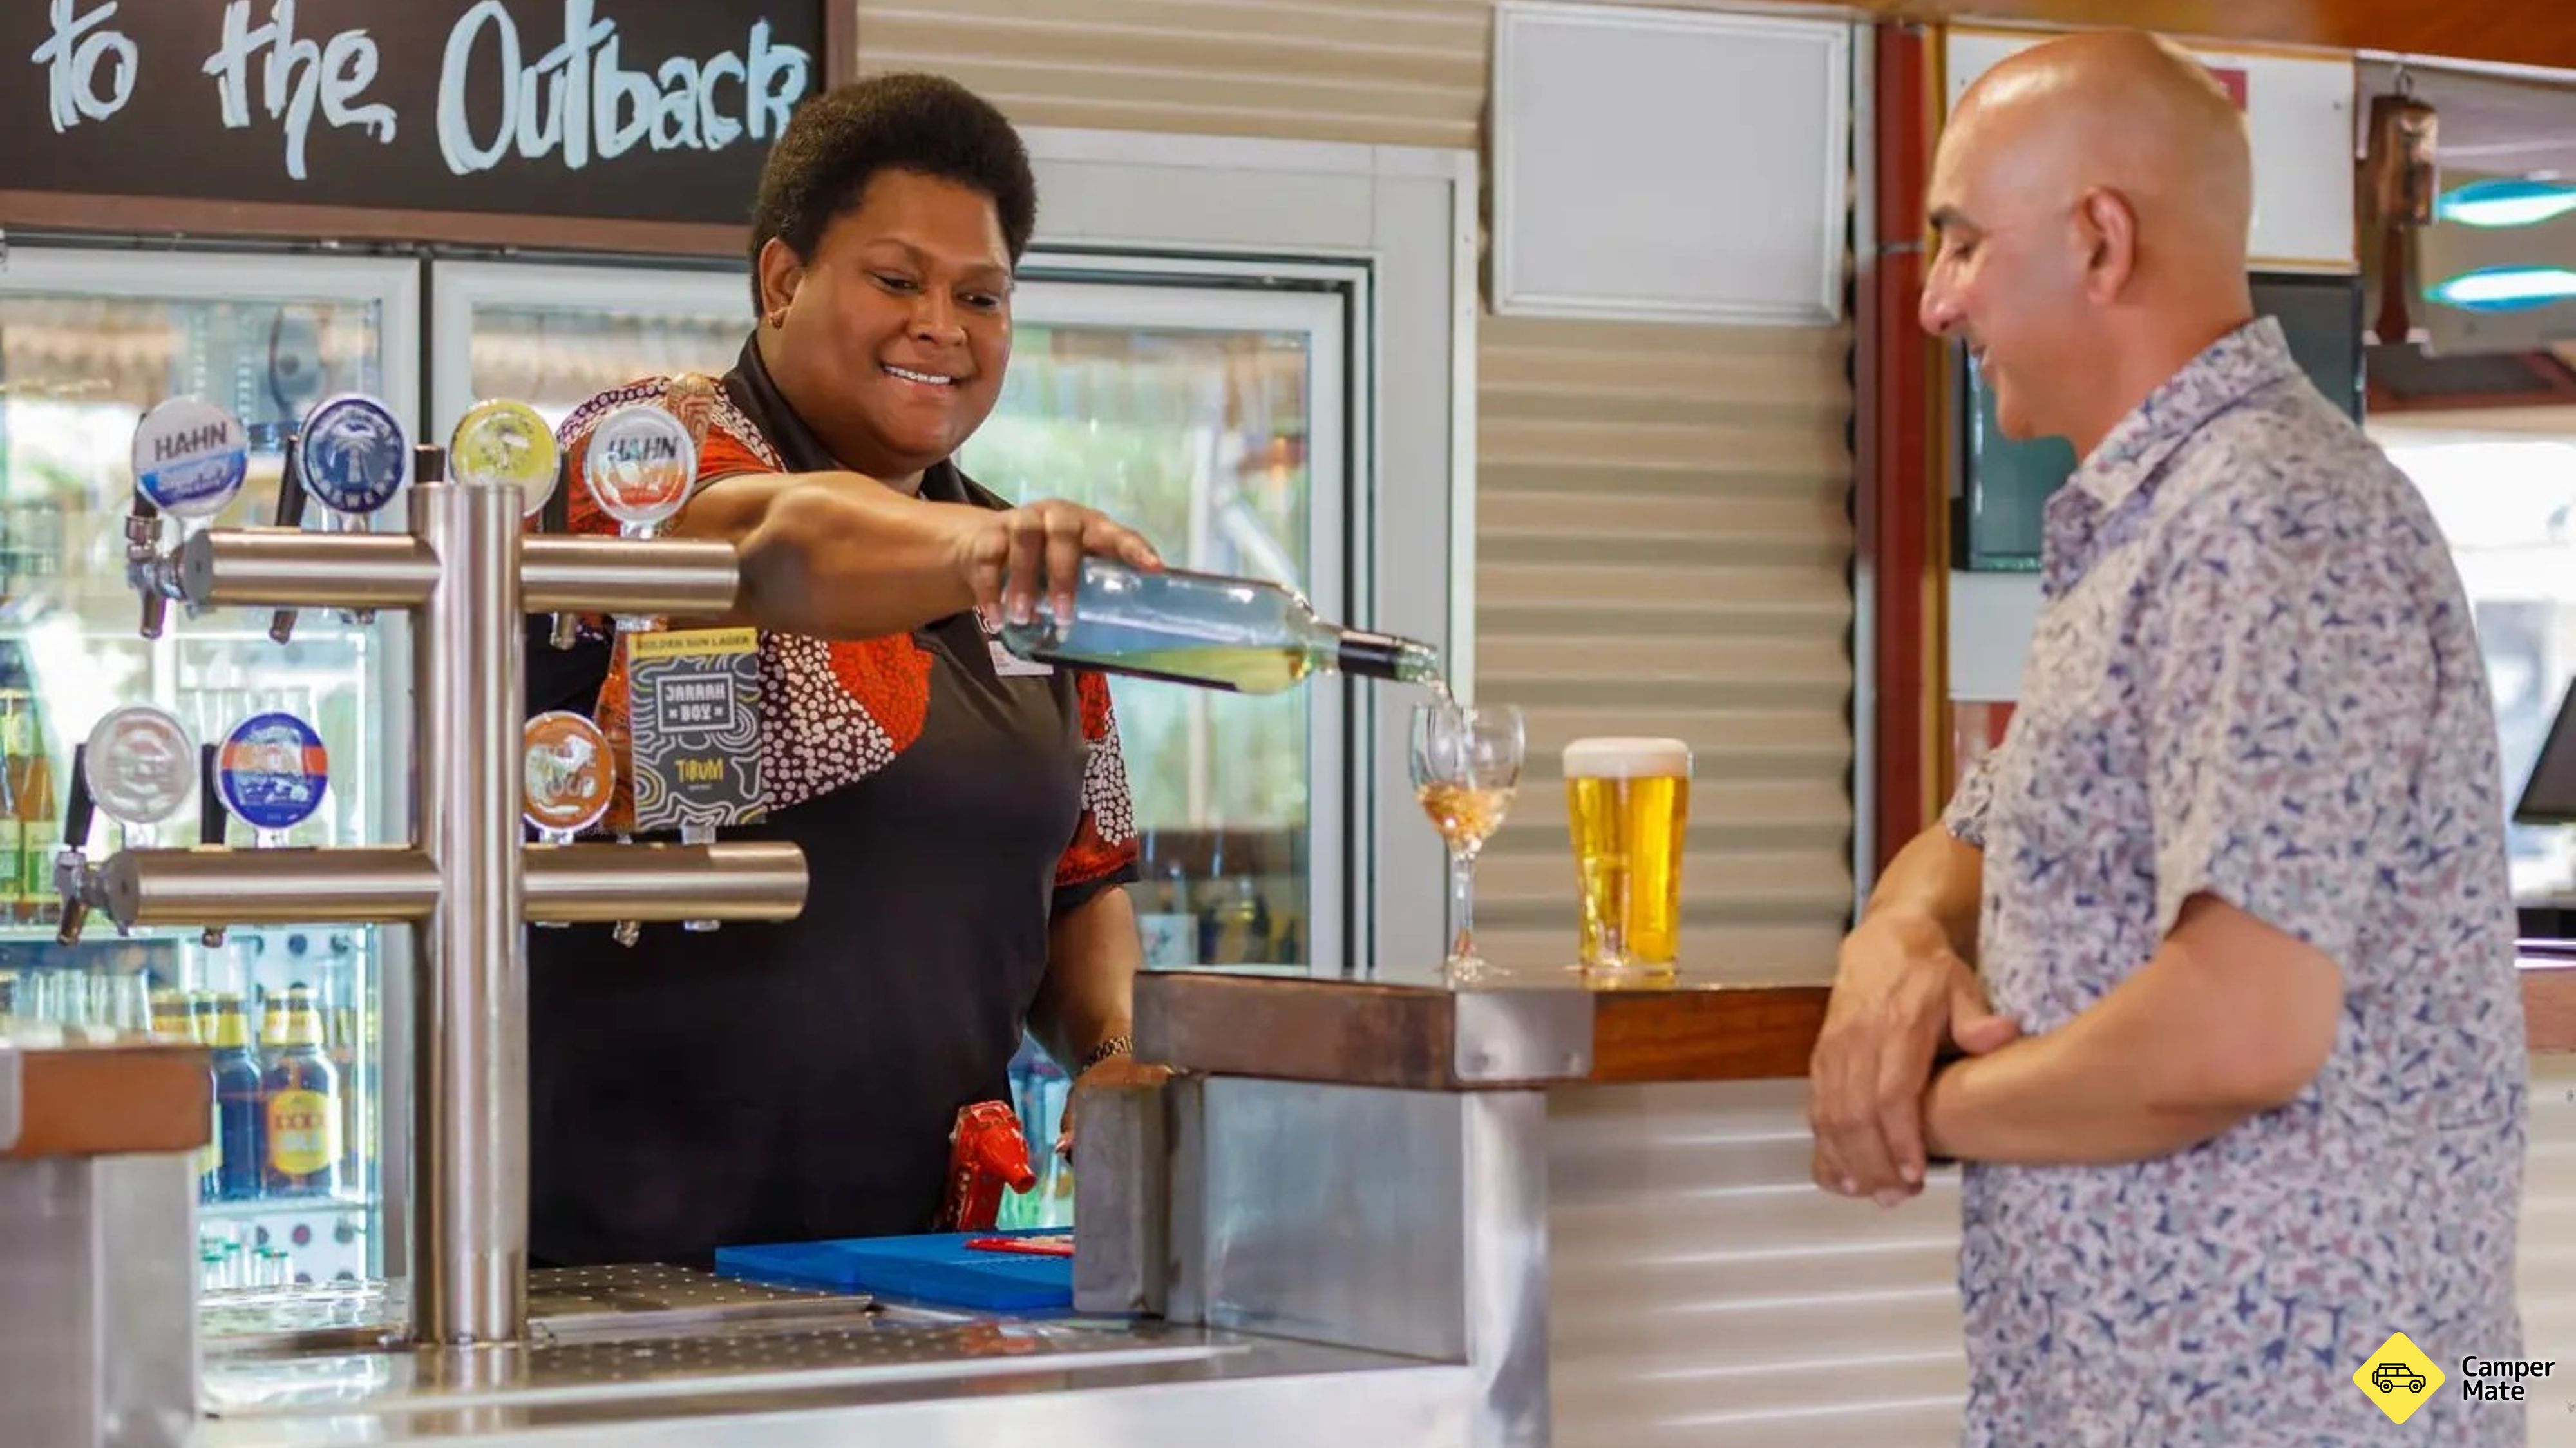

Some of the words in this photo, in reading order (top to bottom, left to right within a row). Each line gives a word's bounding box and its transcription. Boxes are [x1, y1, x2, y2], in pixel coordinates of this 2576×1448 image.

[32, 0, 138, 133] to
[437, 0, 812, 176] Outback
[155, 422, 227, 462] HAHN
[607, 434, 679, 462] HAHN
[665, 682, 726, 702] JARRAH
